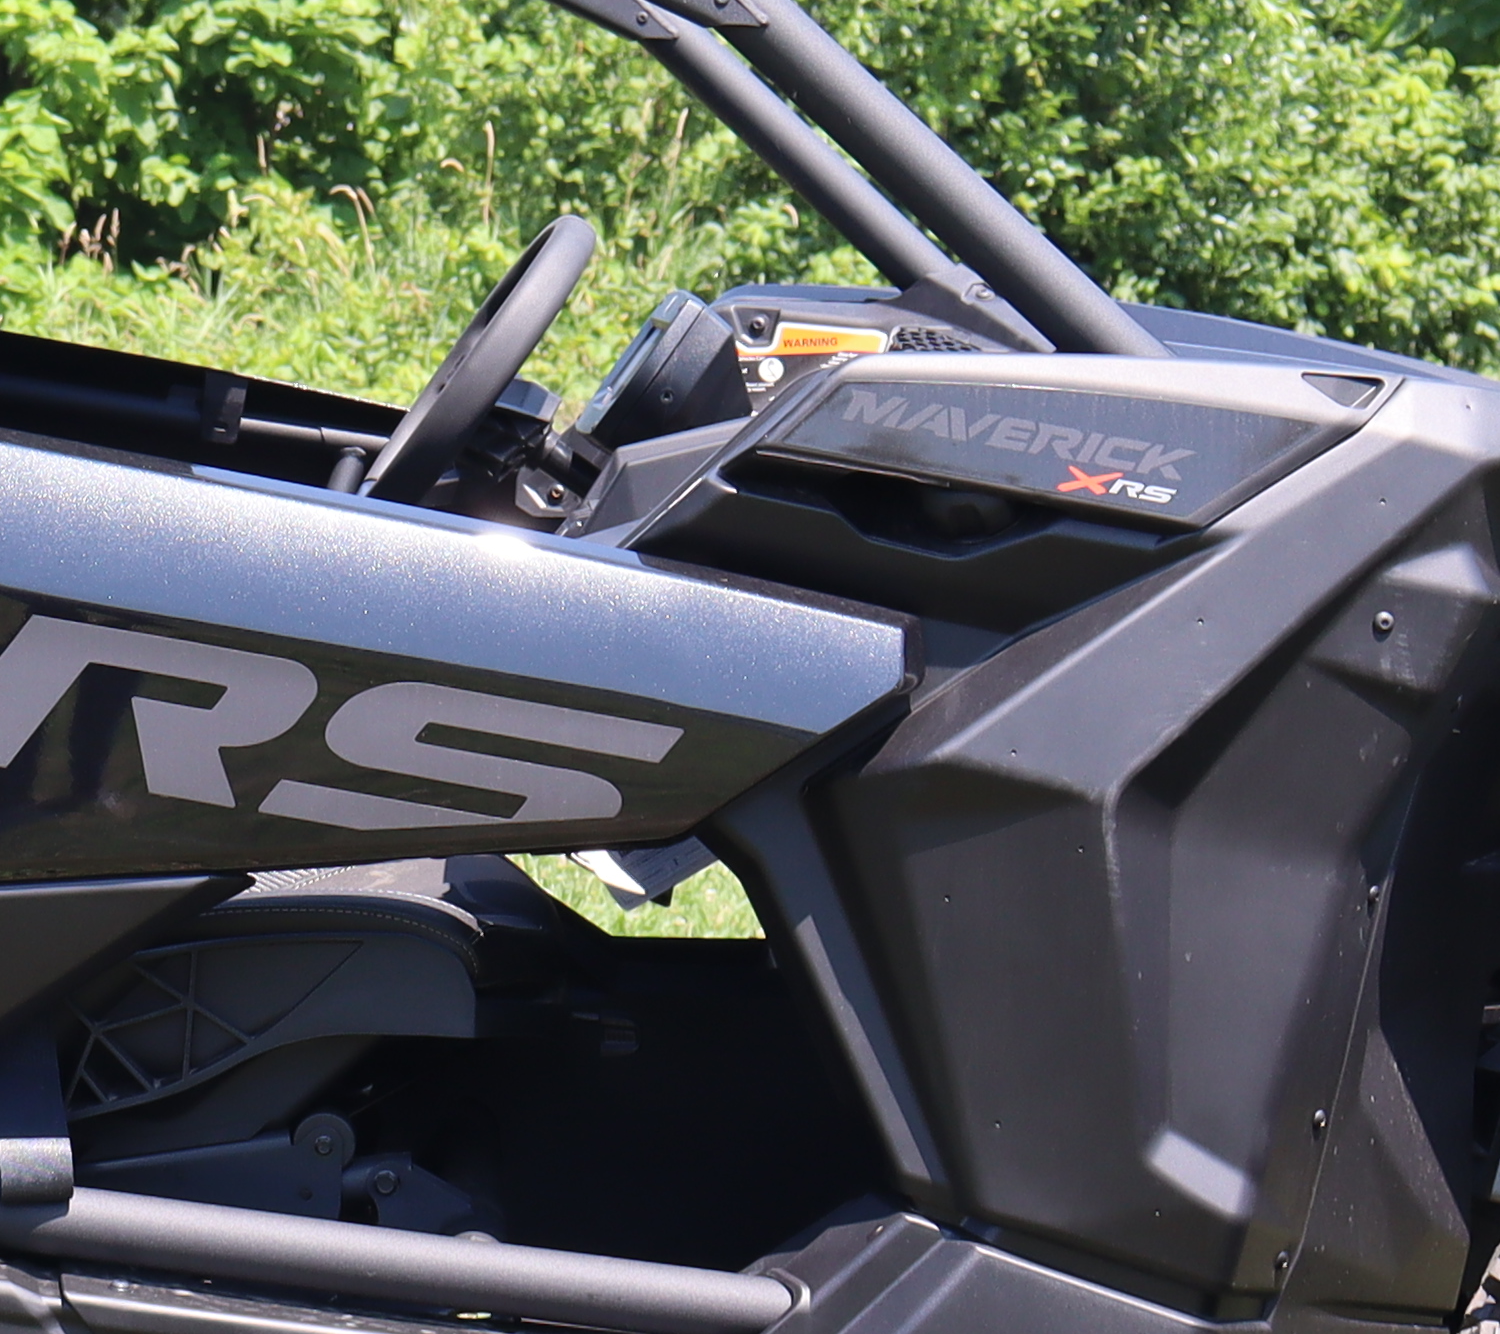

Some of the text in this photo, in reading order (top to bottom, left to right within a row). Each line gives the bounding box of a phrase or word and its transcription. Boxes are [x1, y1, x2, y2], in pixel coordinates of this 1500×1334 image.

[783, 337, 838, 348] WARNING
[841, 389, 1197, 481] MAVERICK
[1056, 465, 1178, 504] XRS
